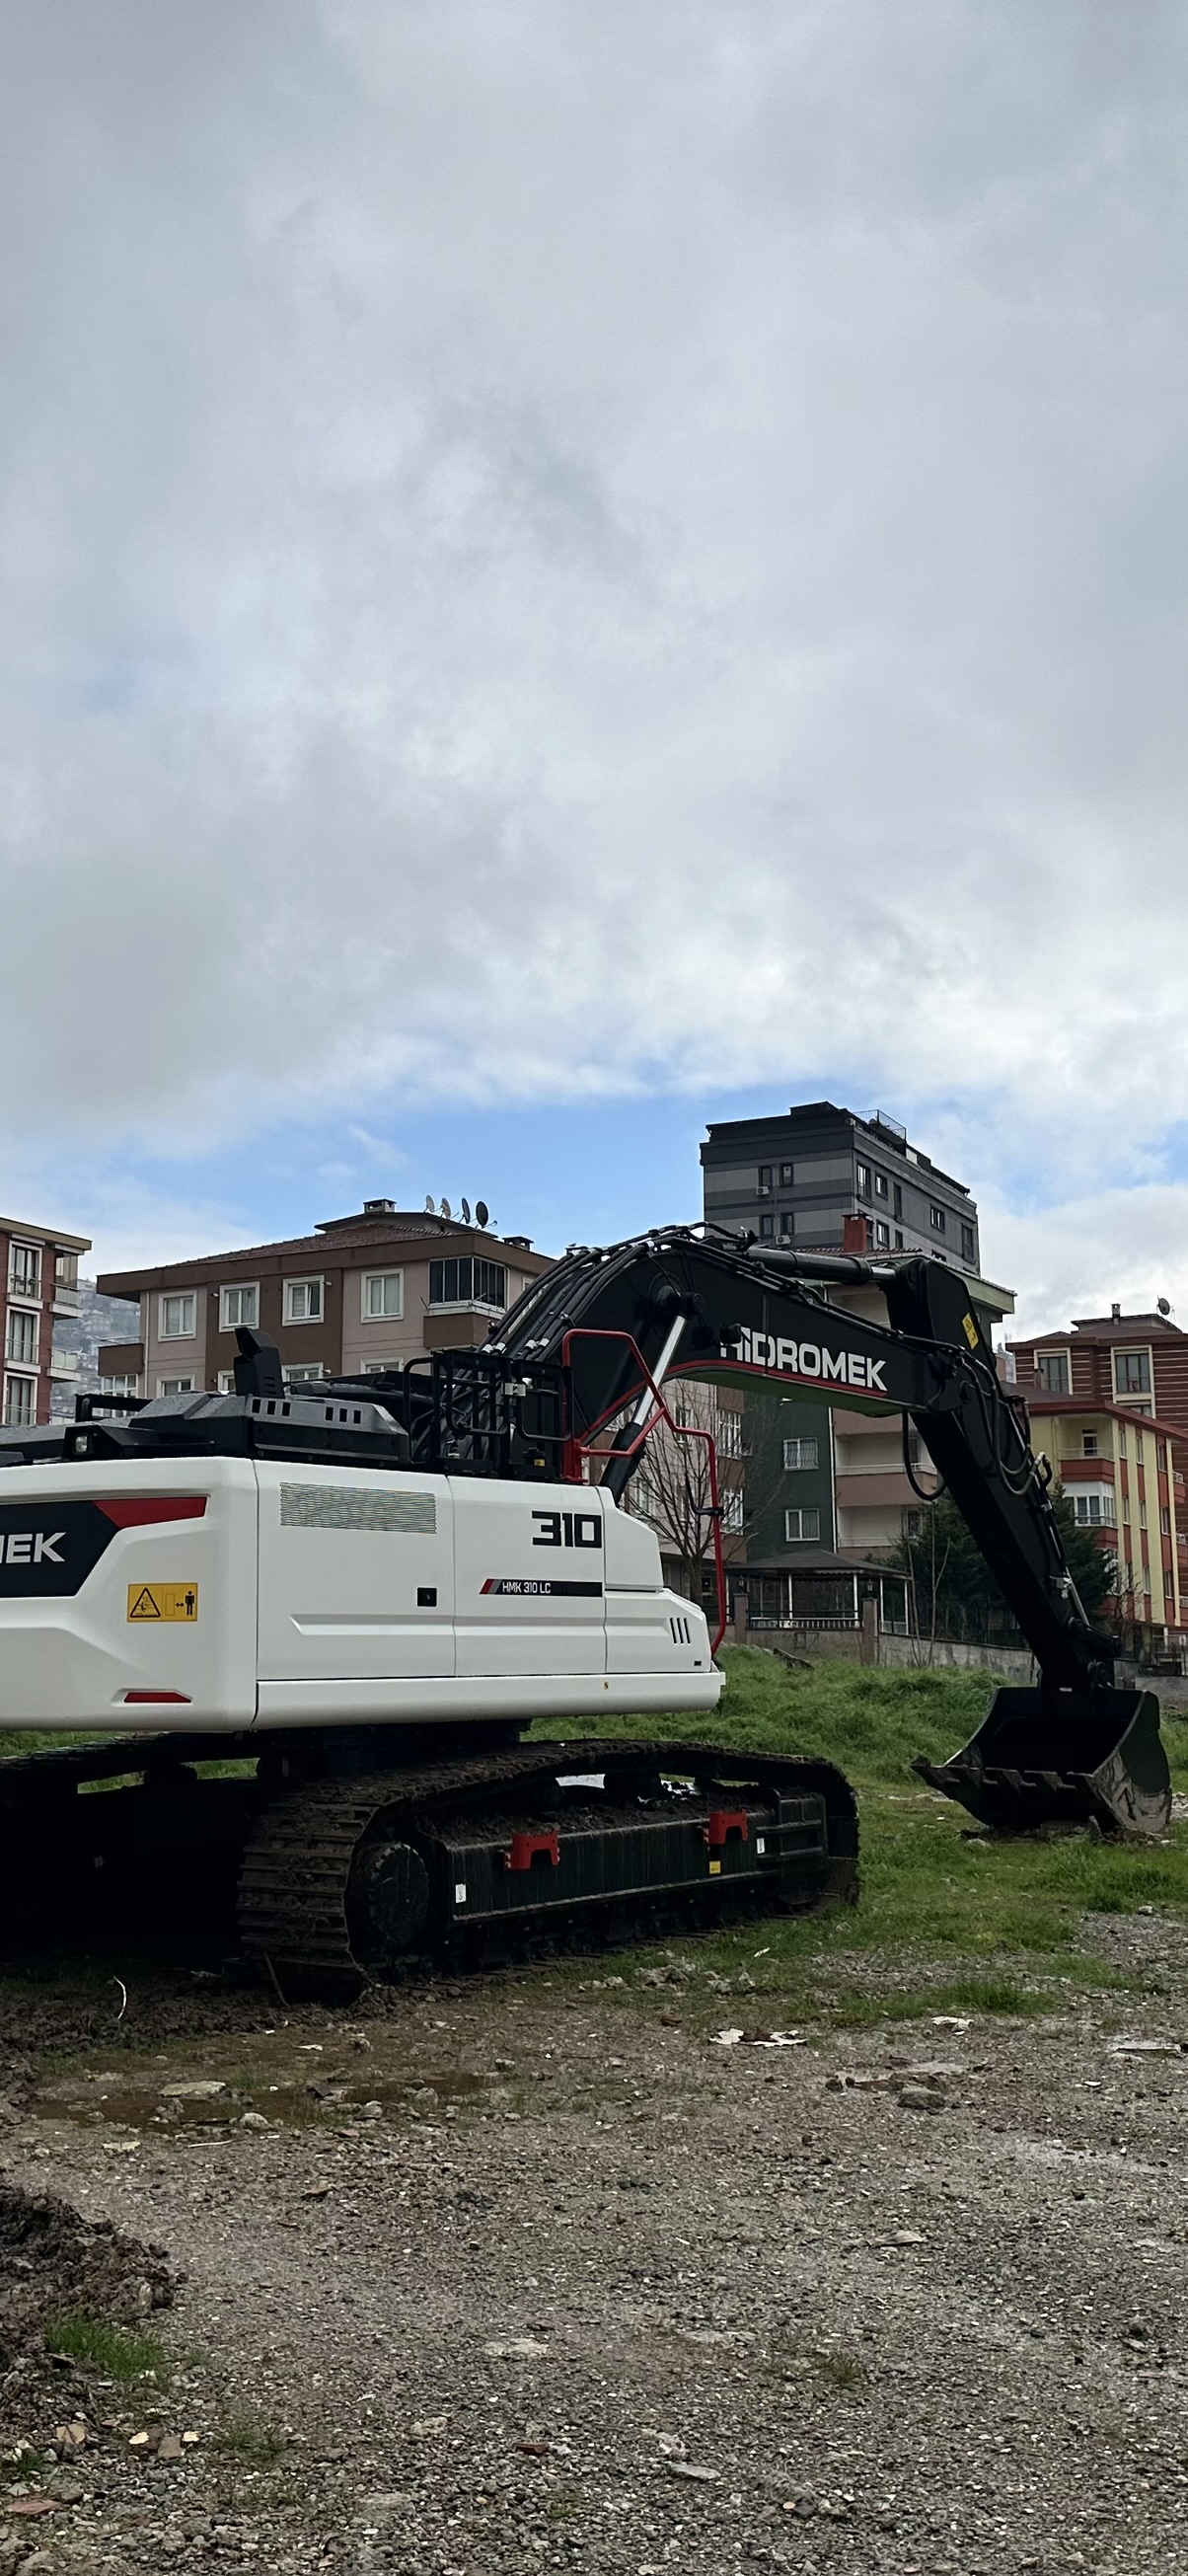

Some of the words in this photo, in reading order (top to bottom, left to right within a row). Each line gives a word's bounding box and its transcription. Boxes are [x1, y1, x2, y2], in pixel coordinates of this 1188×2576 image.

[532, 1510, 602, 1549] 310
[502, 1581, 522, 1594] HMK
[523, 1581, 538, 1594] 310
[540, 1582, 552, 1594] LC
